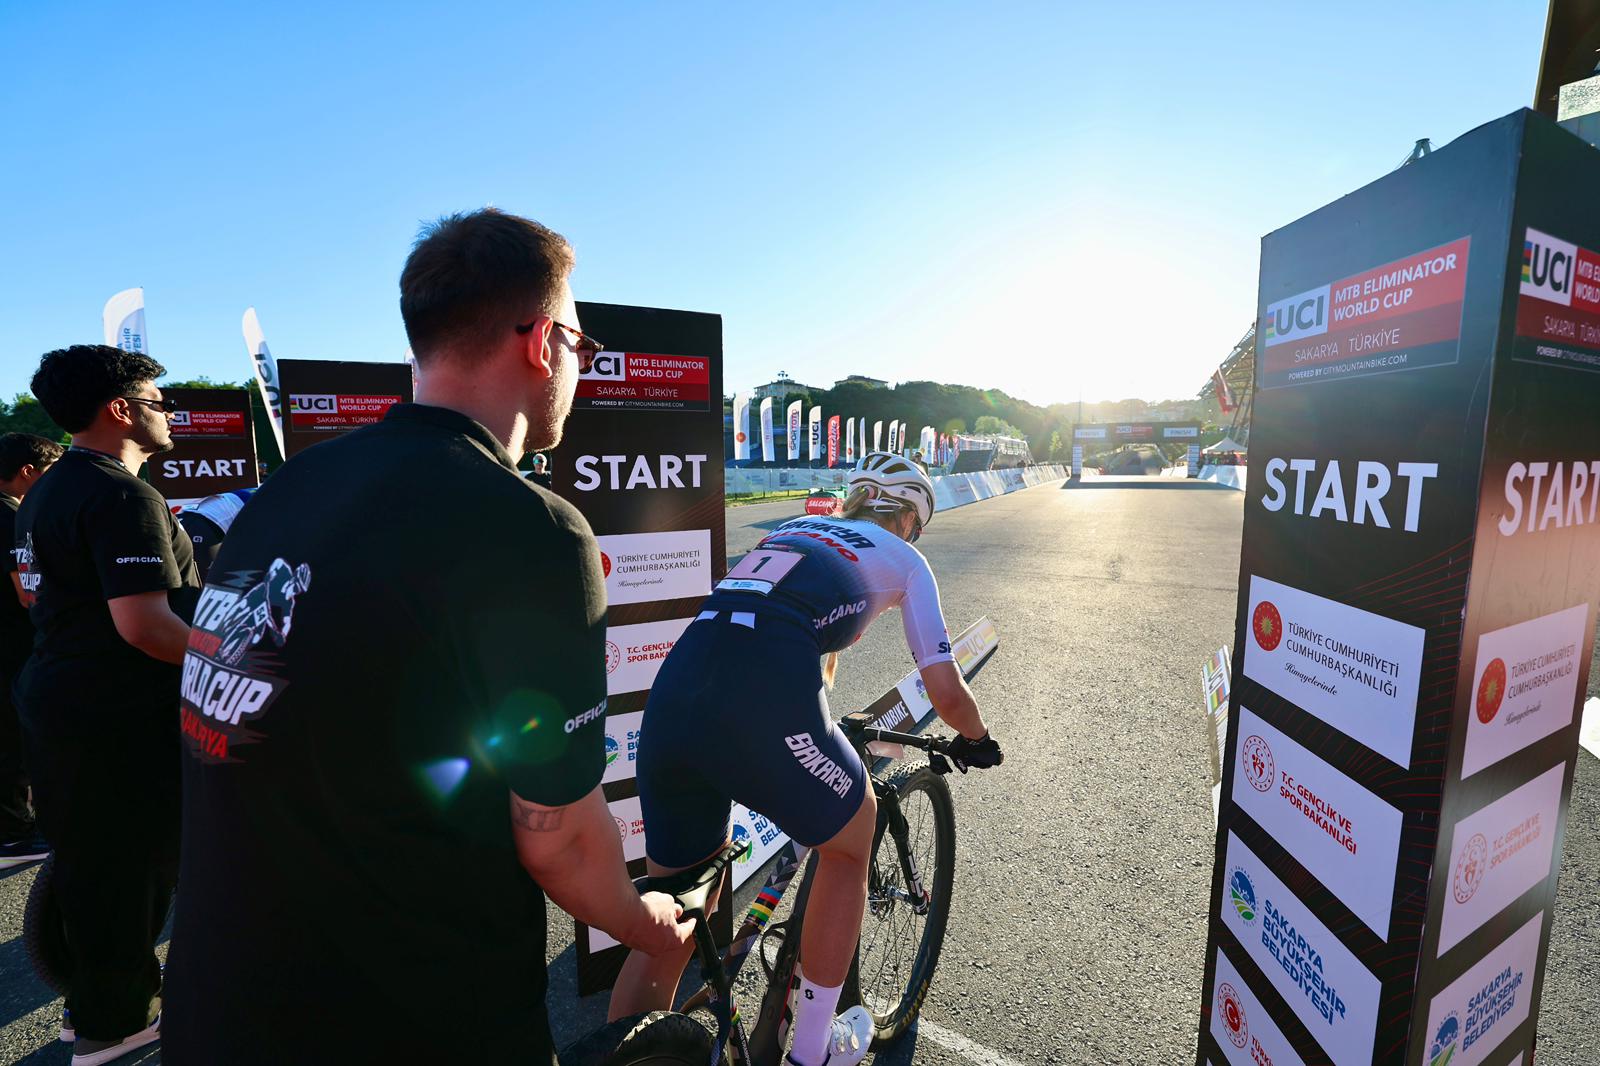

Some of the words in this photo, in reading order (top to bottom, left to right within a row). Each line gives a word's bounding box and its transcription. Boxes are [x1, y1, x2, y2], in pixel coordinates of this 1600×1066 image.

[1335, 284, 1360, 304] MTB
[1364, 253, 1457, 295] ELIMINATOR
[1532, 243, 1572, 294] UCI
[1275, 295, 1324, 336] UCI
[1334, 302, 1379, 322] WORLD
[1383, 287, 1413, 310] CUP
[629, 358, 649, 367] MTB
[651, 359, 704, 370] ELIMINATOR
[1288, 369, 1314, 381] POWERED
[1314, 367, 1323, 377] BY
[1322, 354, 1408, 375] CITYMOUNTAINBIKE.COM
[1294, 341, 1339, 363] SAKARYA
[1349, 328, 1401, 353] TÜRKİYE
[596, 386, 637, 395] SAKARYA
[644, 387, 679, 397] TÜRKİYE
[629, 368, 663, 378] WORLD
[665, 370, 684, 378] CUP
[300, 398, 333, 411] UCI
[162, 459, 246, 478] START
[573, 454, 708, 492] START
[1261, 457, 1438, 533] START
[1499, 460, 1600, 536] START
[116, 556, 163, 564] OFFICIAL
[616, 554, 649, 563] TÜRKİYE
[650, 549, 700, 561] CUMHURİYETİ
[616, 560, 701, 573] CUMHURBAŞKANLIĞI
[751, 556, 772, 573] 1
[627, 654, 648, 663] SPOR
[1286, 639, 1397, 698] CUMHURBAŞKANLIĞI
[1288, 622, 1324, 646] TÜRKİYE
[1325, 637, 1399, 678] CUMHURİYETİ
[203, 670, 273, 725] CUP
[1284, 662, 1338, 696] Himayelerinde
[784, 732, 853, 799] SAKARYA
[1280, 785, 1302, 811] SPOR
[1303, 804, 1357, 854] BAKANLIĞI
[1281, 771, 1296, 790] T.C.
[1297, 784, 1337, 822] GENÇLİK
[1338, 814, 1352, 833] VE
[1264, 899, 1324, 974] SAKARYA
[1261, 930, 1335, 1026] BELEDİYESİ
[1263, 914, 1346, 1020] BÜYÜKŞEHİR
[1465, 972, 1523, 1033] BÜYÜKŞEHİR
[1467, 966, 1511, 1013] SAKARYA
[1462, 990, 1516, 1053] BELEDİYESİ
